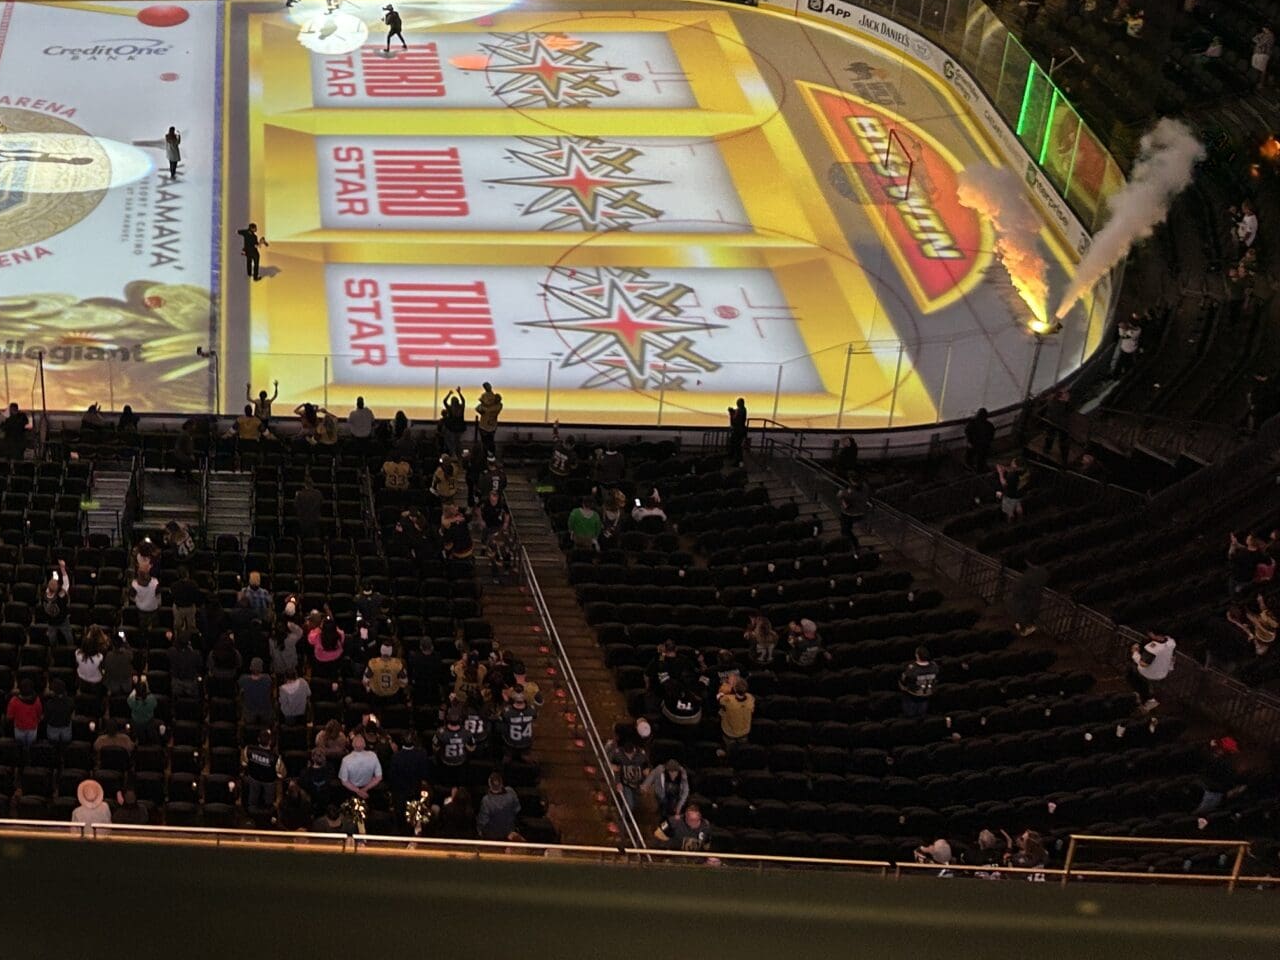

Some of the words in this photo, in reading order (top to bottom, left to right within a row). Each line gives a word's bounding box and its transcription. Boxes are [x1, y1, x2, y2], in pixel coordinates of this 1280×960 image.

[325, 53, 357, 98] TAR
[361, 41, 447, 98] THIRD
[334, 146, 370, 217] STAR
[373, 146, 470, 218] THIRD
[344, 278, 388, 367] STAR
[389, 280, 501, 369] THIRD
